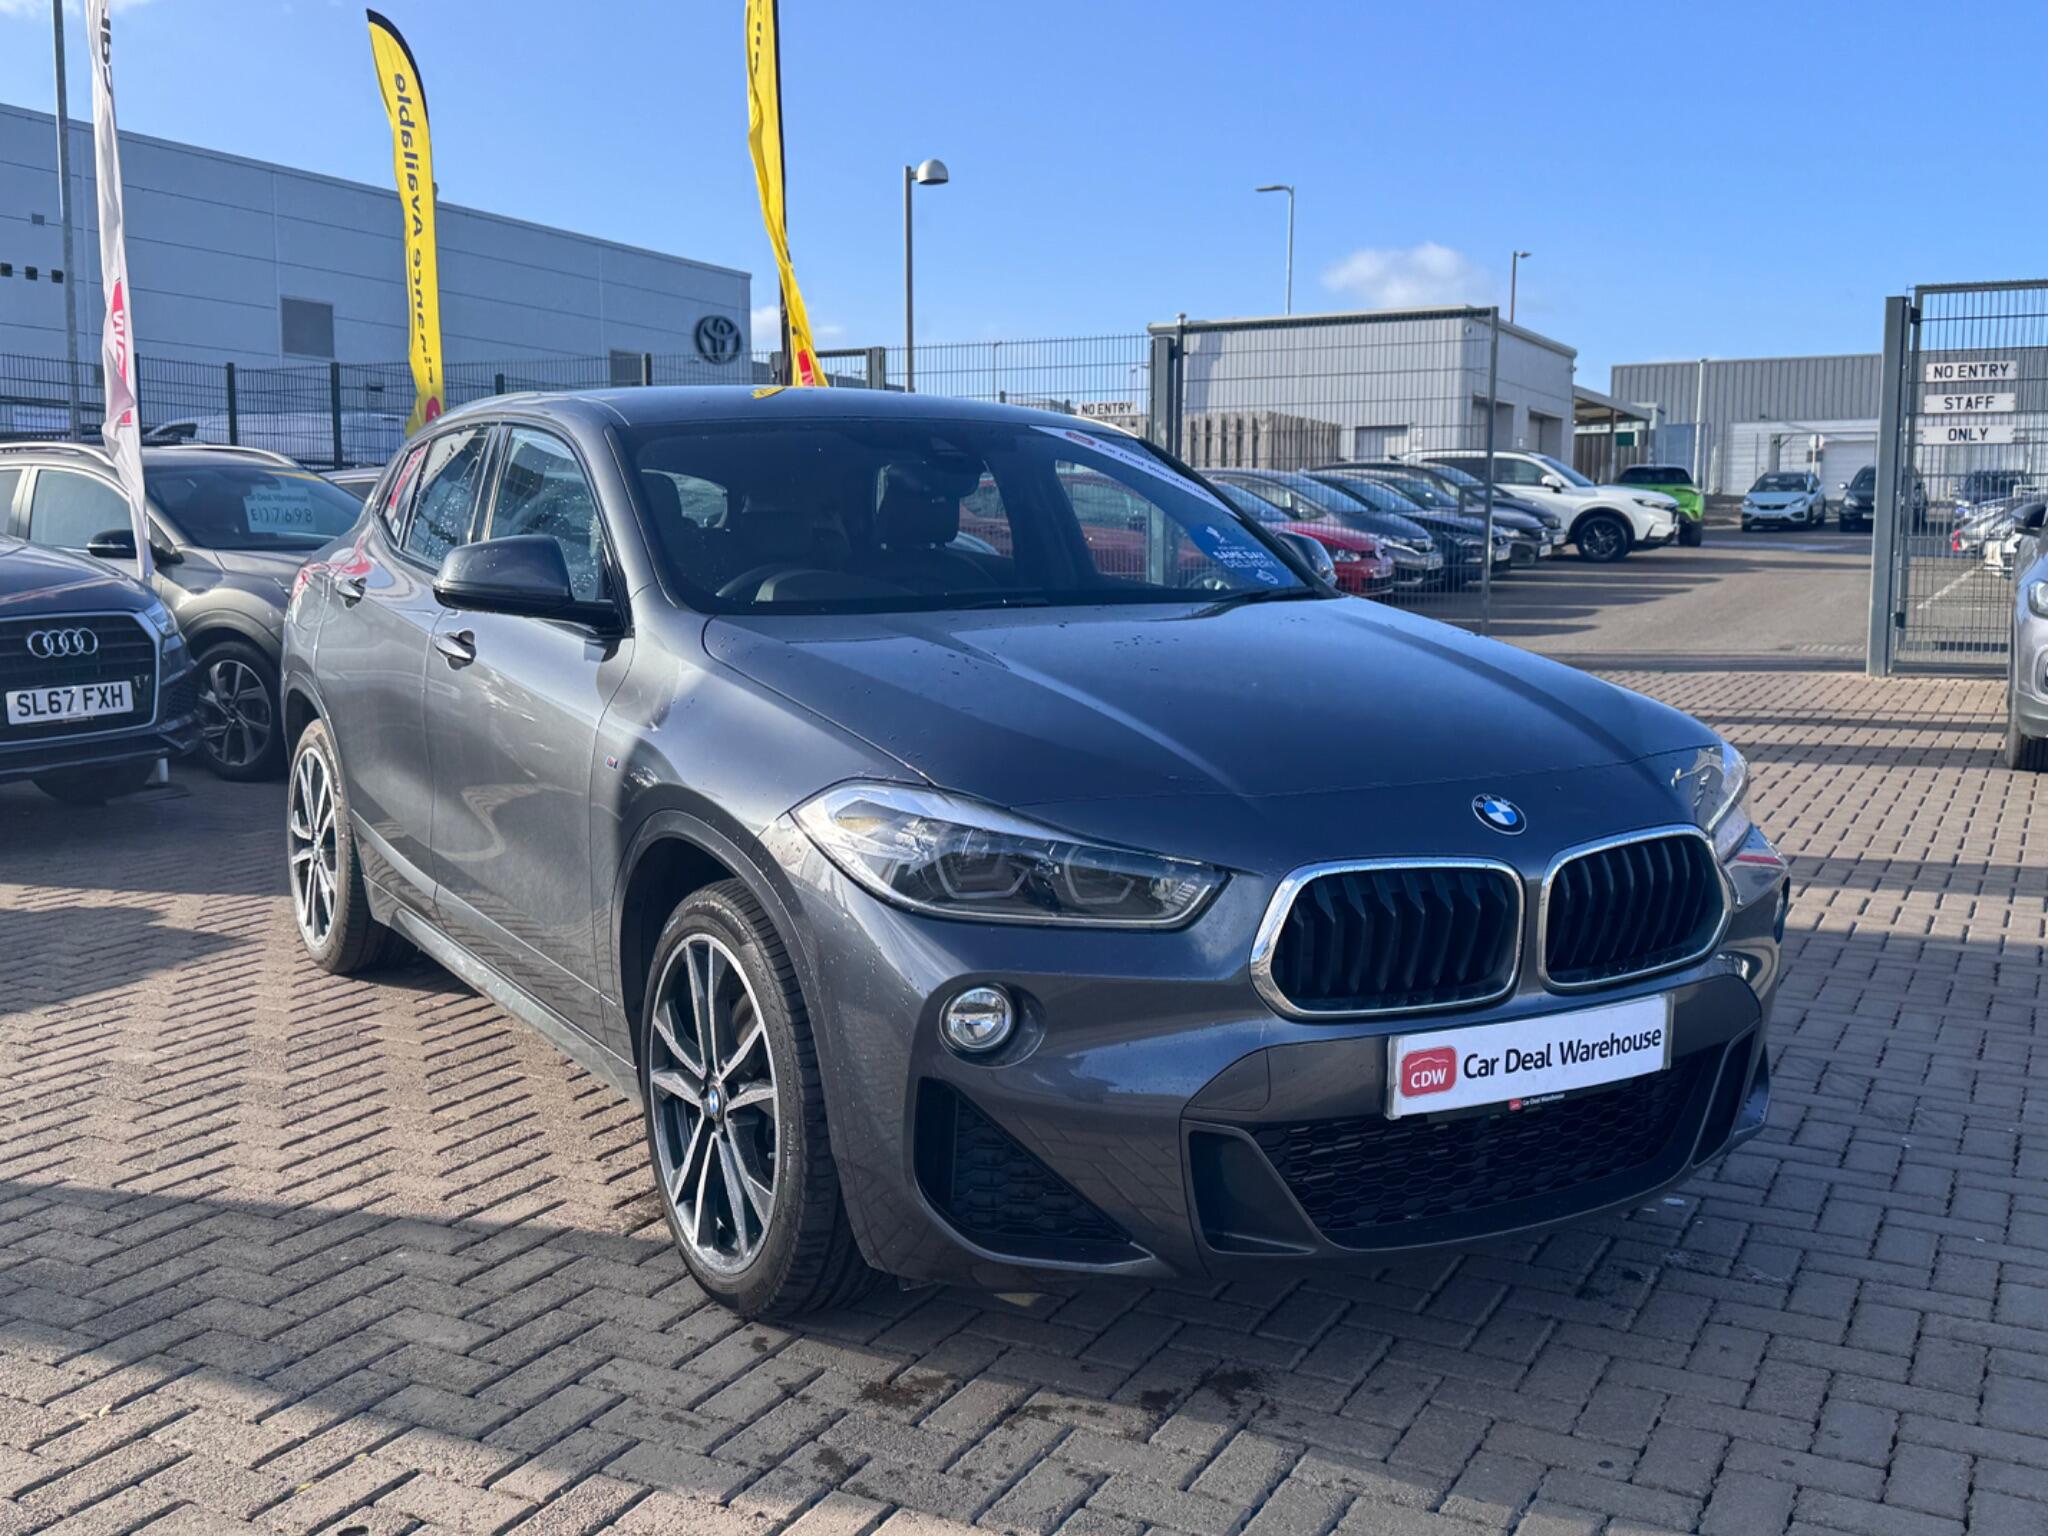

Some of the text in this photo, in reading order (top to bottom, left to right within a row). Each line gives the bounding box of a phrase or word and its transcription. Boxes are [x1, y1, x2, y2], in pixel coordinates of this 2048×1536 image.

[1934, 363, 2009, 379] NO ENTRY
[1082, 402, 1133, 415] NO ENTRY
[1944, 395, 1995, 410] STAFF
[1948, 427, 1989, 441] ONLY
[17, 684, 124, 717] SL67 FXH
[1463, 1028, 1662, 1079] Car Deal Warehouse
[1410, 1067, 1448, 1089] CDW
